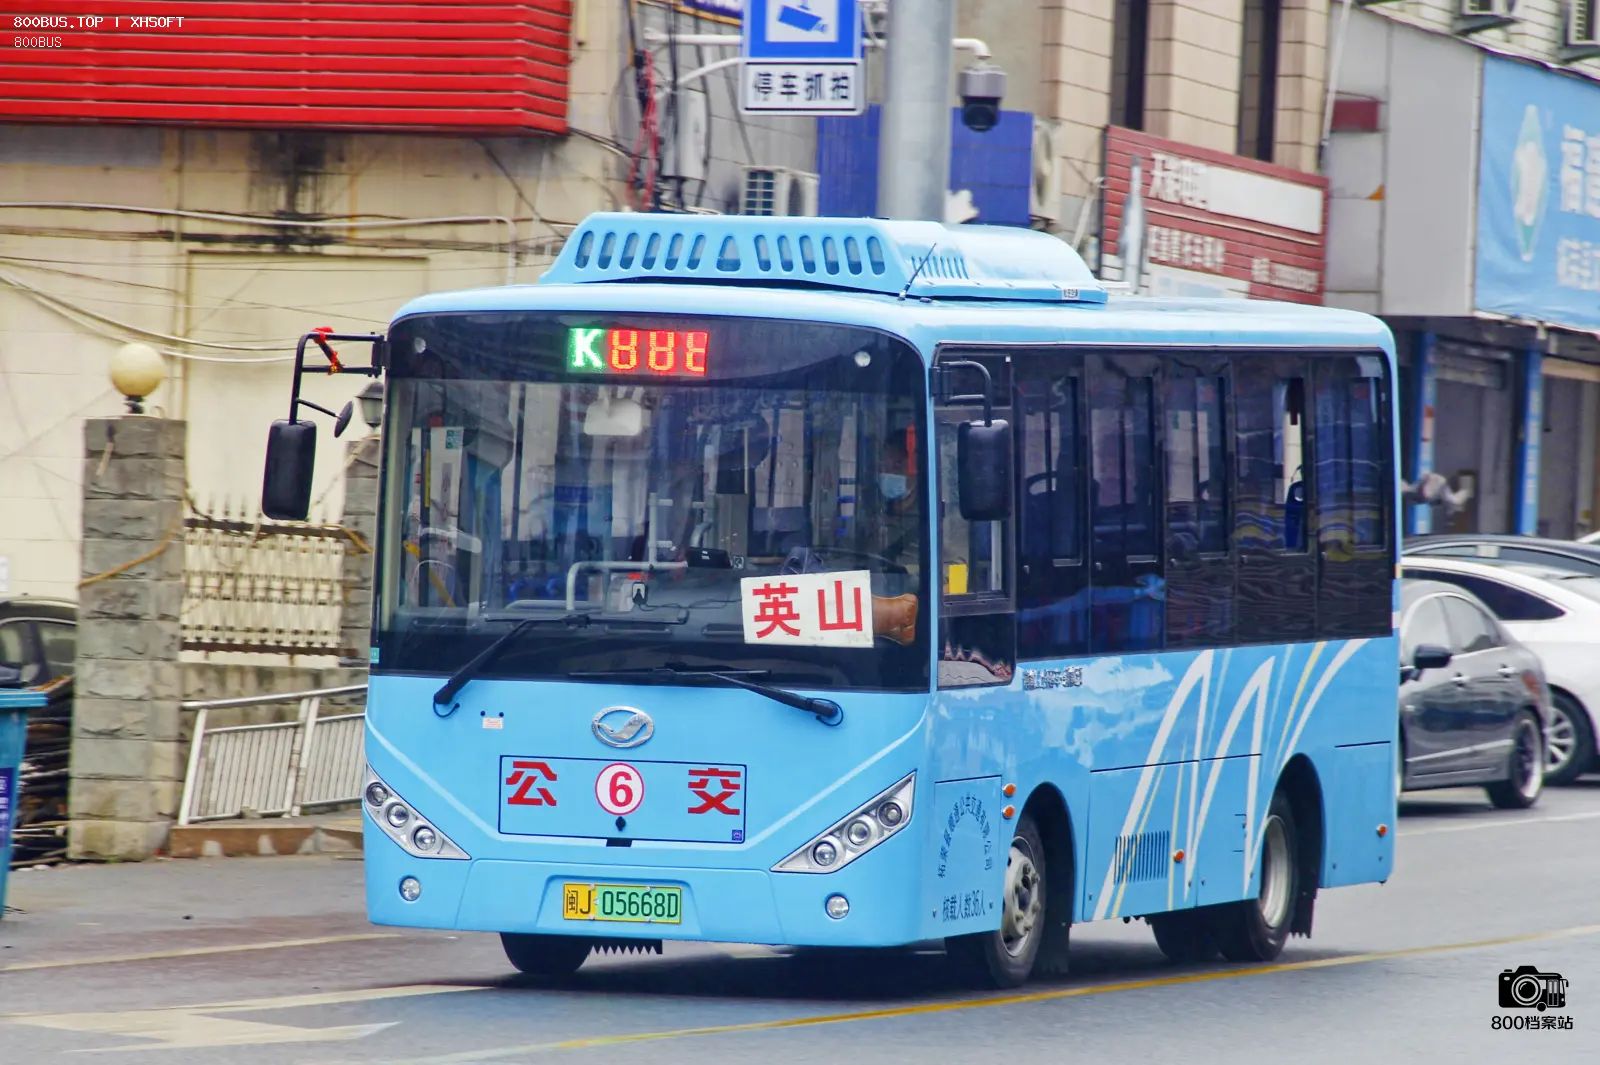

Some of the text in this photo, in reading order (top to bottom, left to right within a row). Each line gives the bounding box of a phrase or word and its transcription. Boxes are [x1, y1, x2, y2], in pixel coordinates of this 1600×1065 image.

[753, 72, 850, 101] 停车抓拍
[752, 580, 863, 639] 英山
